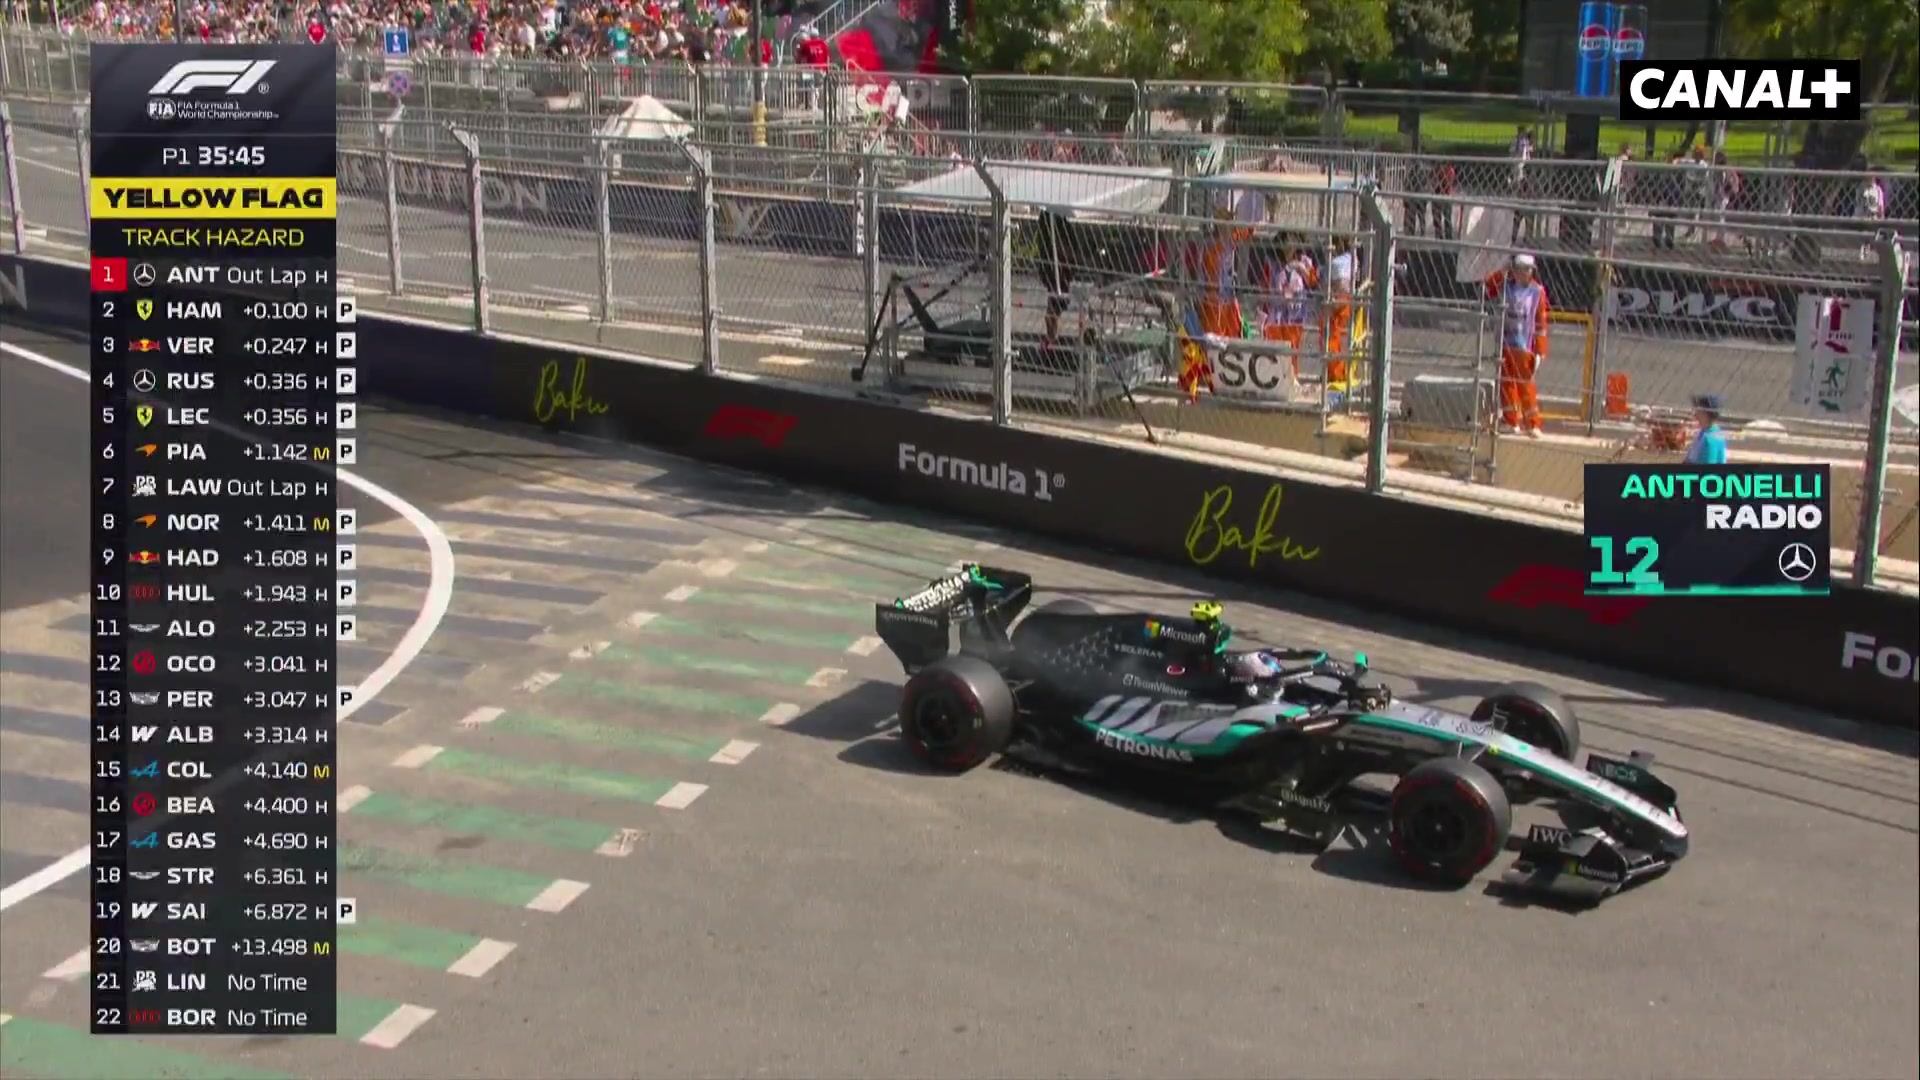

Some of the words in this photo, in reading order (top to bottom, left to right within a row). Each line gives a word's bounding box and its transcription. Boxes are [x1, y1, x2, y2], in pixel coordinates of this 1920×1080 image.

[1218, 350, 1279, 389] SC
[533, 357, 608, 422] Baku
[899, 442, 1026, 495] Formula
[1185, 483, 1320, 568] Baku
[1160, 625, 1207, 645] Microsoft
[1133, 675, 1190, 697] TeamViewer
[1096, 728, 1194, 762] PETRONAS
